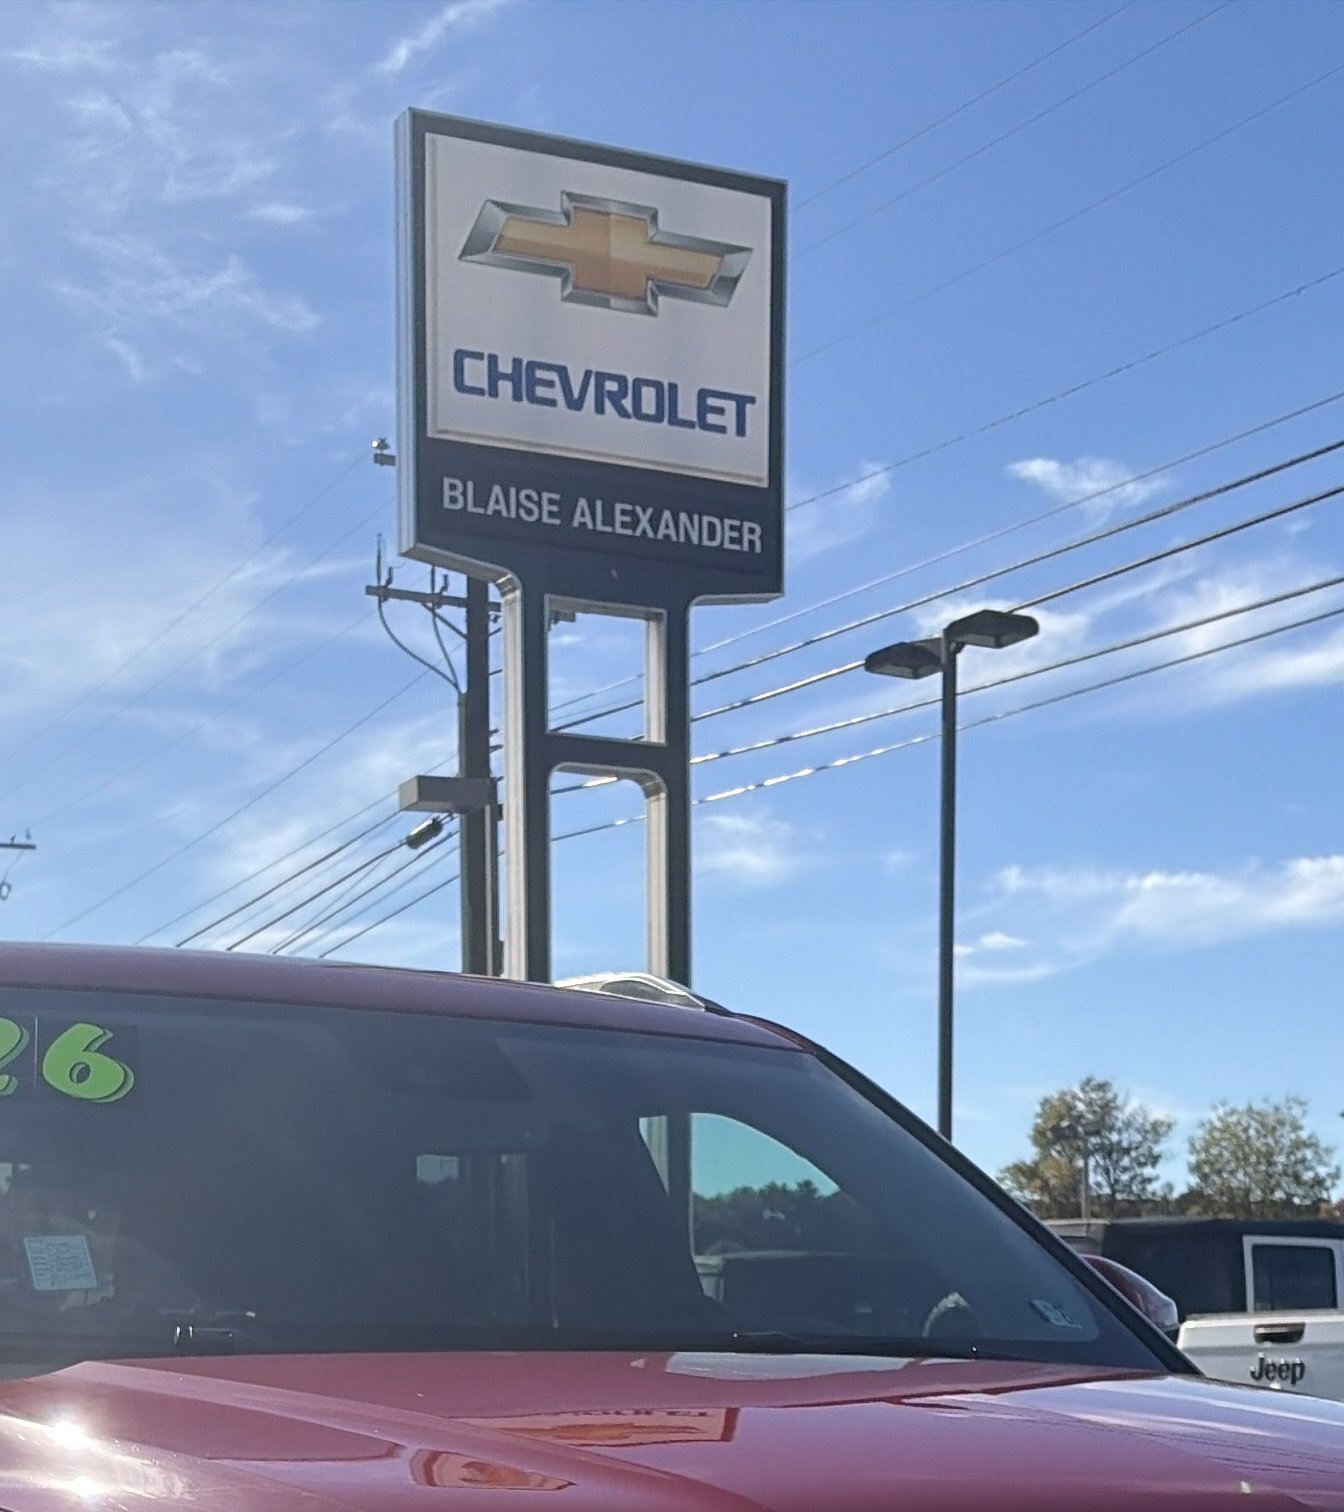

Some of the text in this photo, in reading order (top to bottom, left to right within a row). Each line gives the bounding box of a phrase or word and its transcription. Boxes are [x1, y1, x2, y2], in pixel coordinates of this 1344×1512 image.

[453, 348, 756, 437] CHEVROLET
[442, 477, 762, 553] BLAISE ALEXANDER
[1249, 1352, 1306, 1386] Jeep
